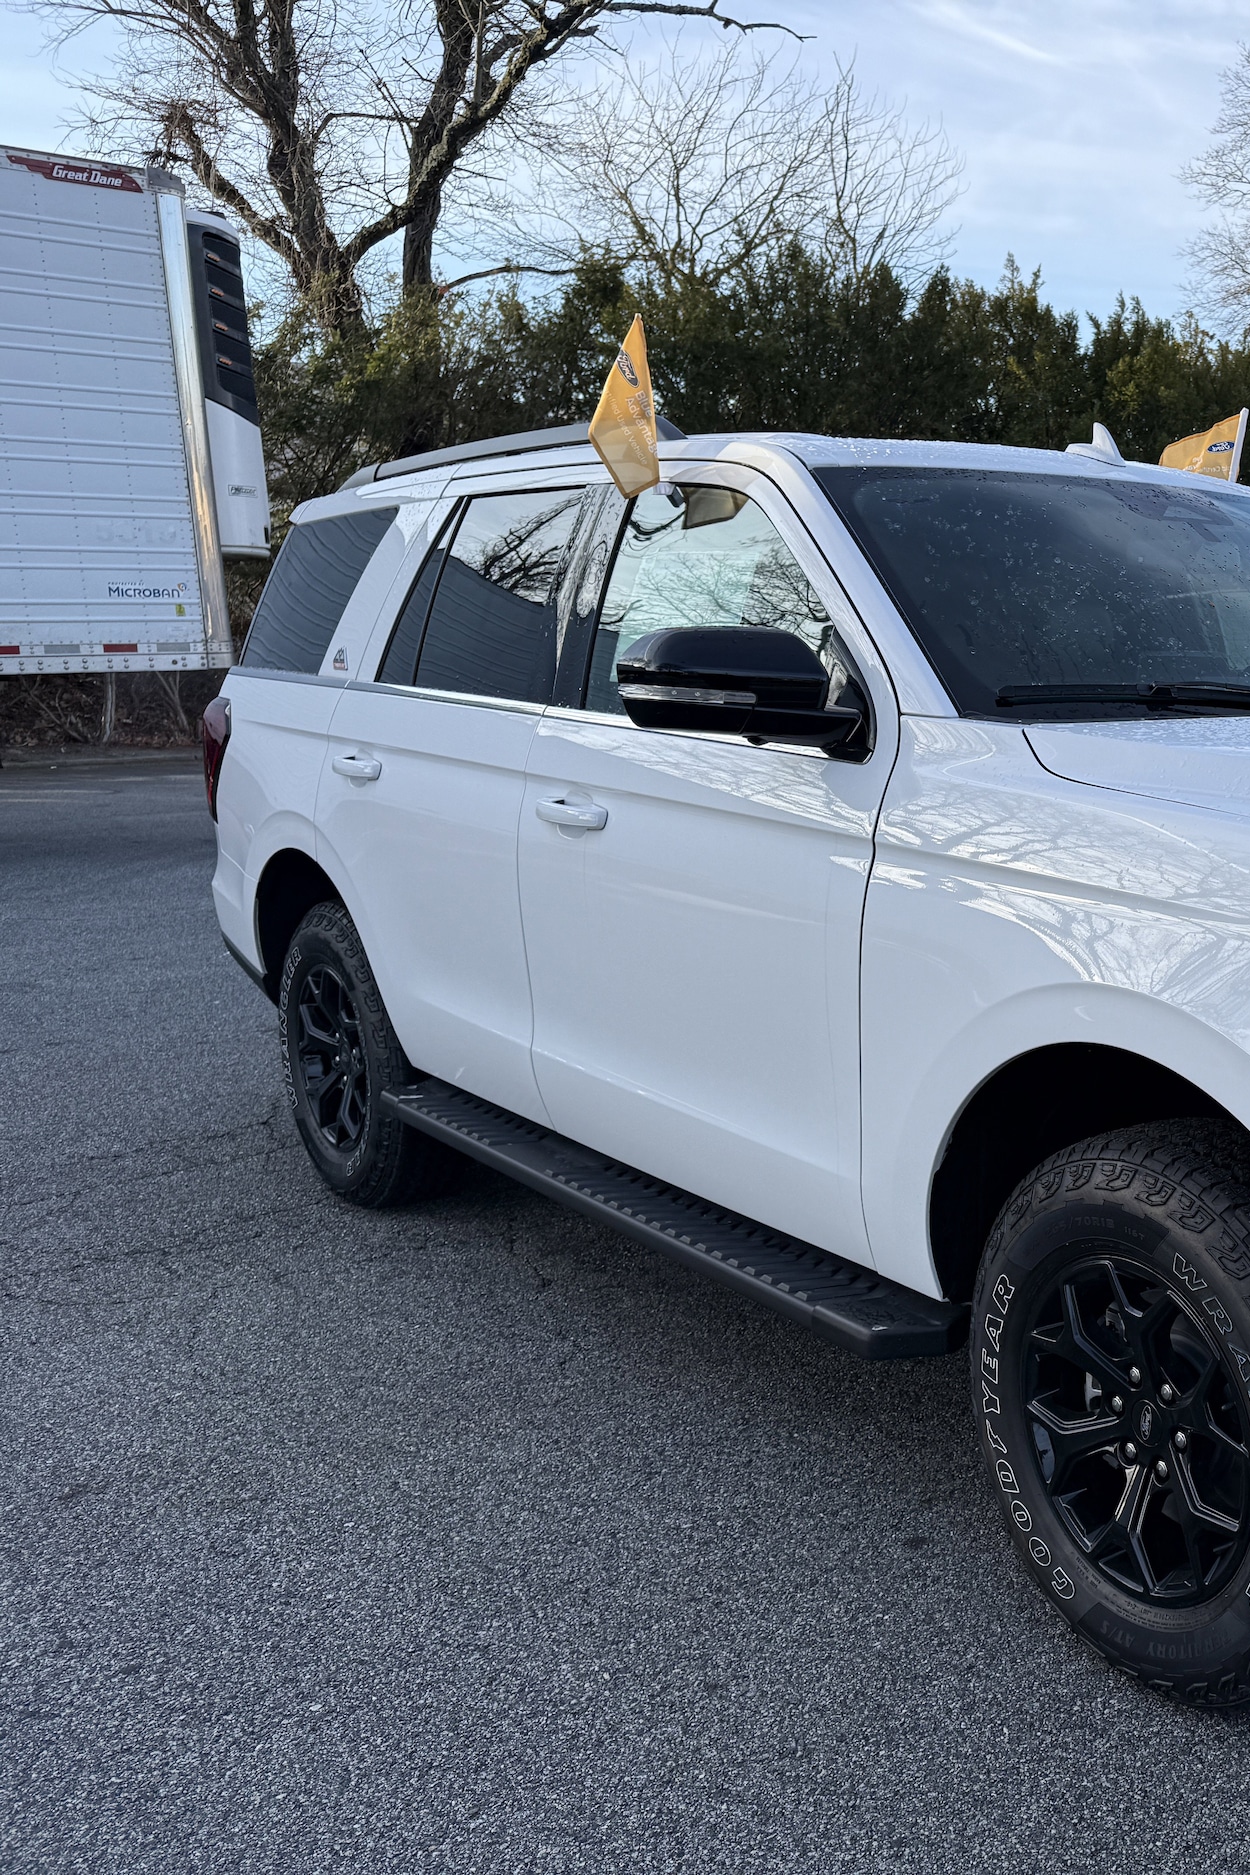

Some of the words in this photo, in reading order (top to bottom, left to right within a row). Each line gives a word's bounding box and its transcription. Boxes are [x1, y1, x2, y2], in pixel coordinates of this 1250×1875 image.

[52, 165, 89, 182] Great
[89, 170, 123, 187] Dane
[617, 353, 636, 381] Ford
[635, 390, 653, 418] Blue
[628, 435, 648, 465] Vehicle
[108, 585, 181, 598] MICROBAN
[279, 947, 302, 1109] WRANGLER
[980, 1273, 1076, 1600] GOODYEAR
